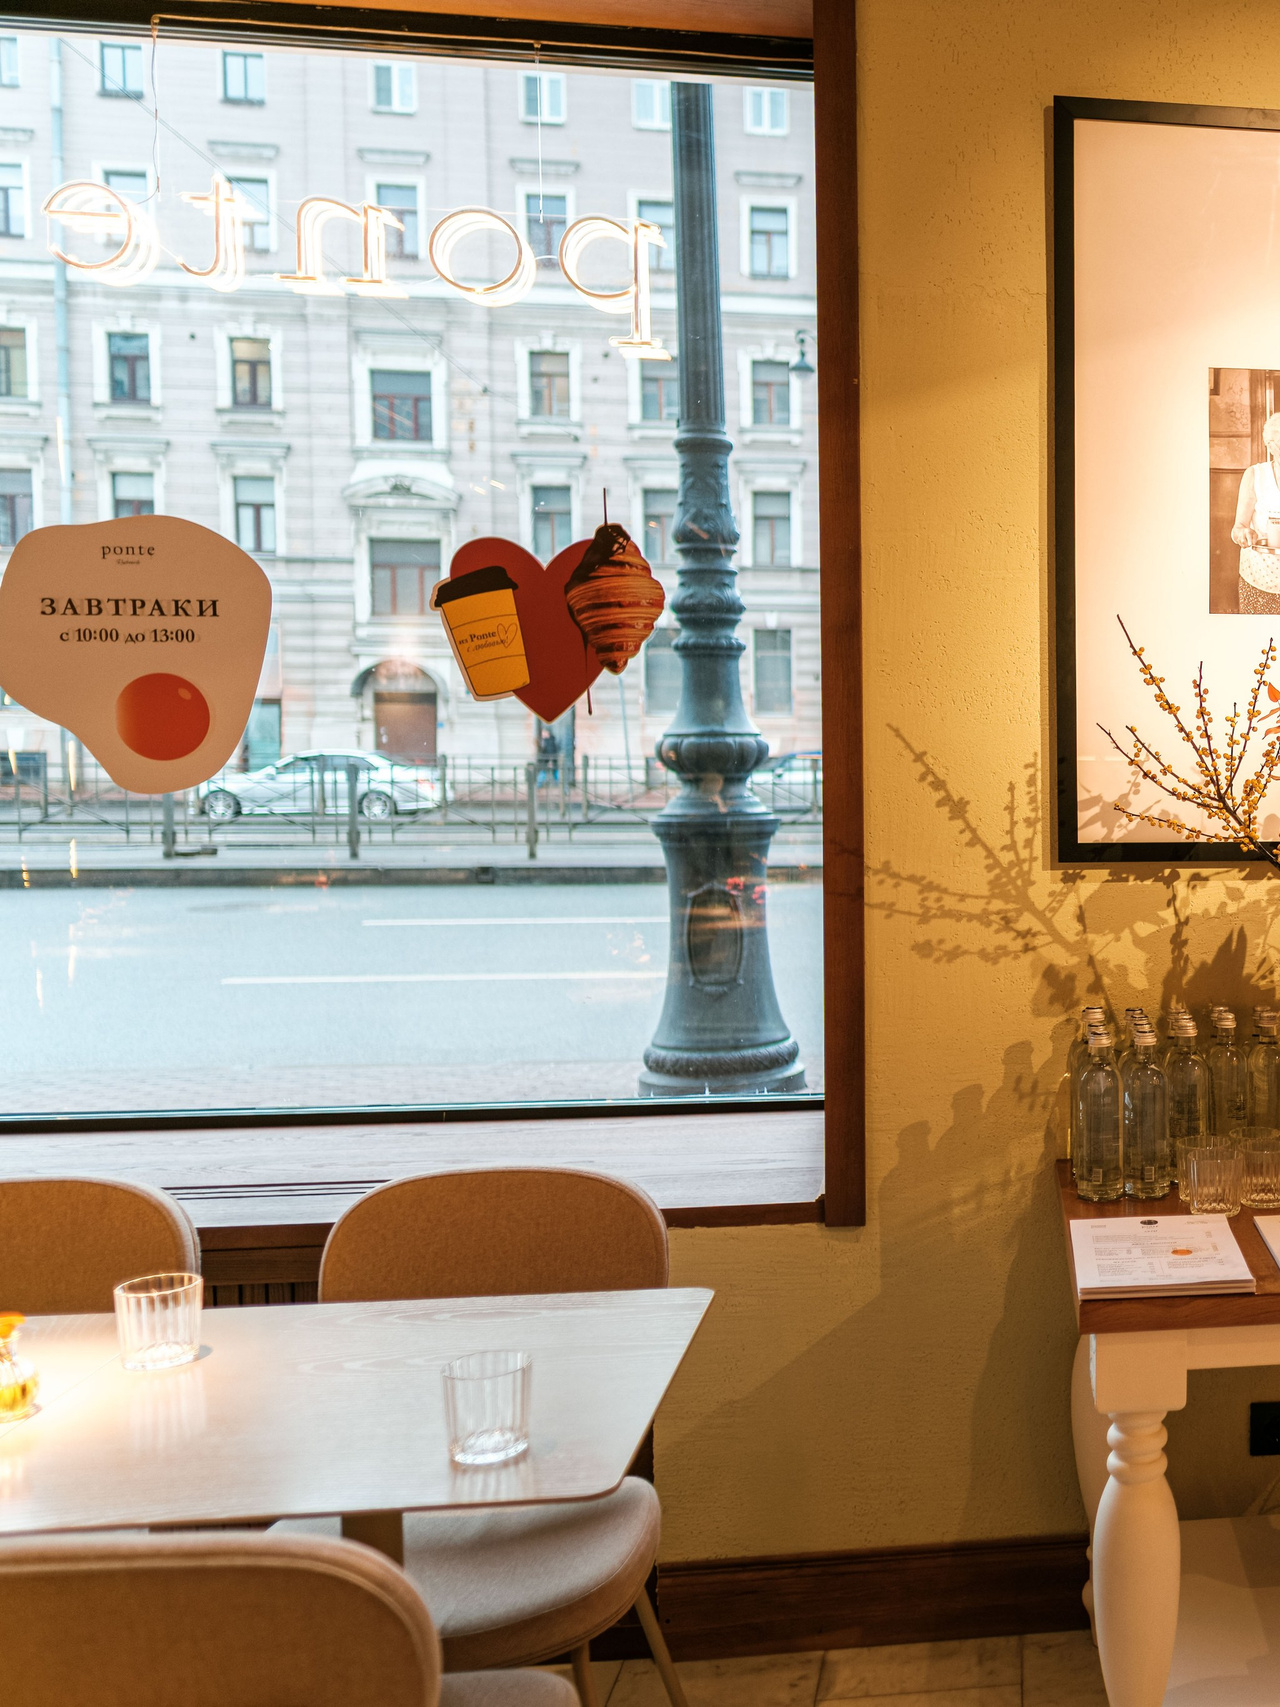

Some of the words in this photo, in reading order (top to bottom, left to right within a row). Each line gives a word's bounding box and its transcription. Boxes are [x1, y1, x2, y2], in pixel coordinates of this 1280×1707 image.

[101, 545, 156, 560] ponte
[40, 597, 220, 618] ЗАВТРАКИ
[59, 631, 70, 642] с
[75, 628, 120, 643] 10:00
[125, 632, 146, 645] до
[152, 628, 196, 643] 13:00
[469, 631, 497, 643] Ponte
